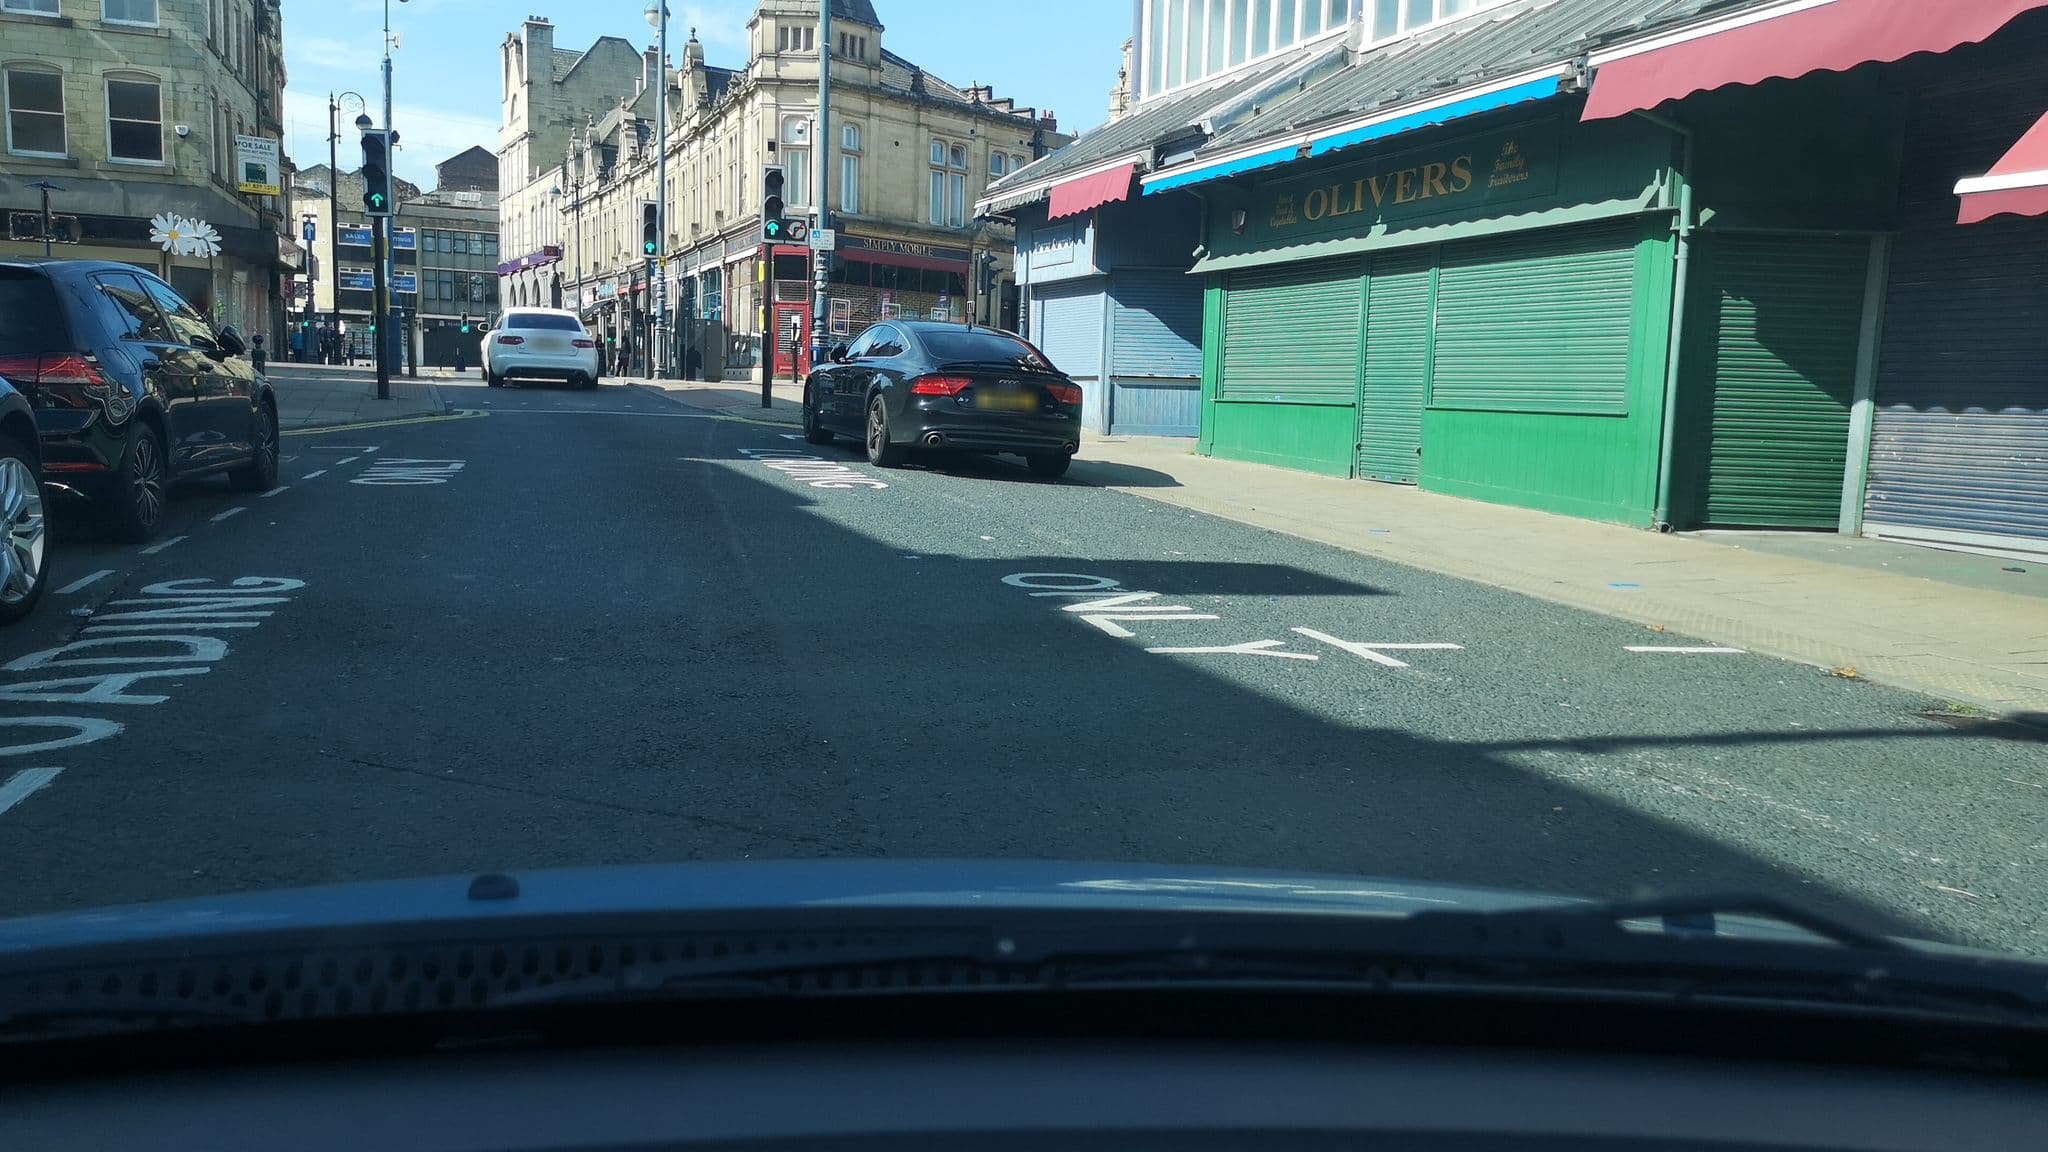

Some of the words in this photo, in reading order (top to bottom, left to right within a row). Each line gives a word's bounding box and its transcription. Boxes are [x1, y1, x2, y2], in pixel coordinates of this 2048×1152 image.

[238, 140, 253, 149] FOR
[254, 143, 272, 151] SALE
[1303, 155, 1472, 221] OLIVERS
[863, 238, 896, 252] SIMPLY
[900, 242, 934, 257] MOBILE
[1000, 572, 1319, 660] ONLY
